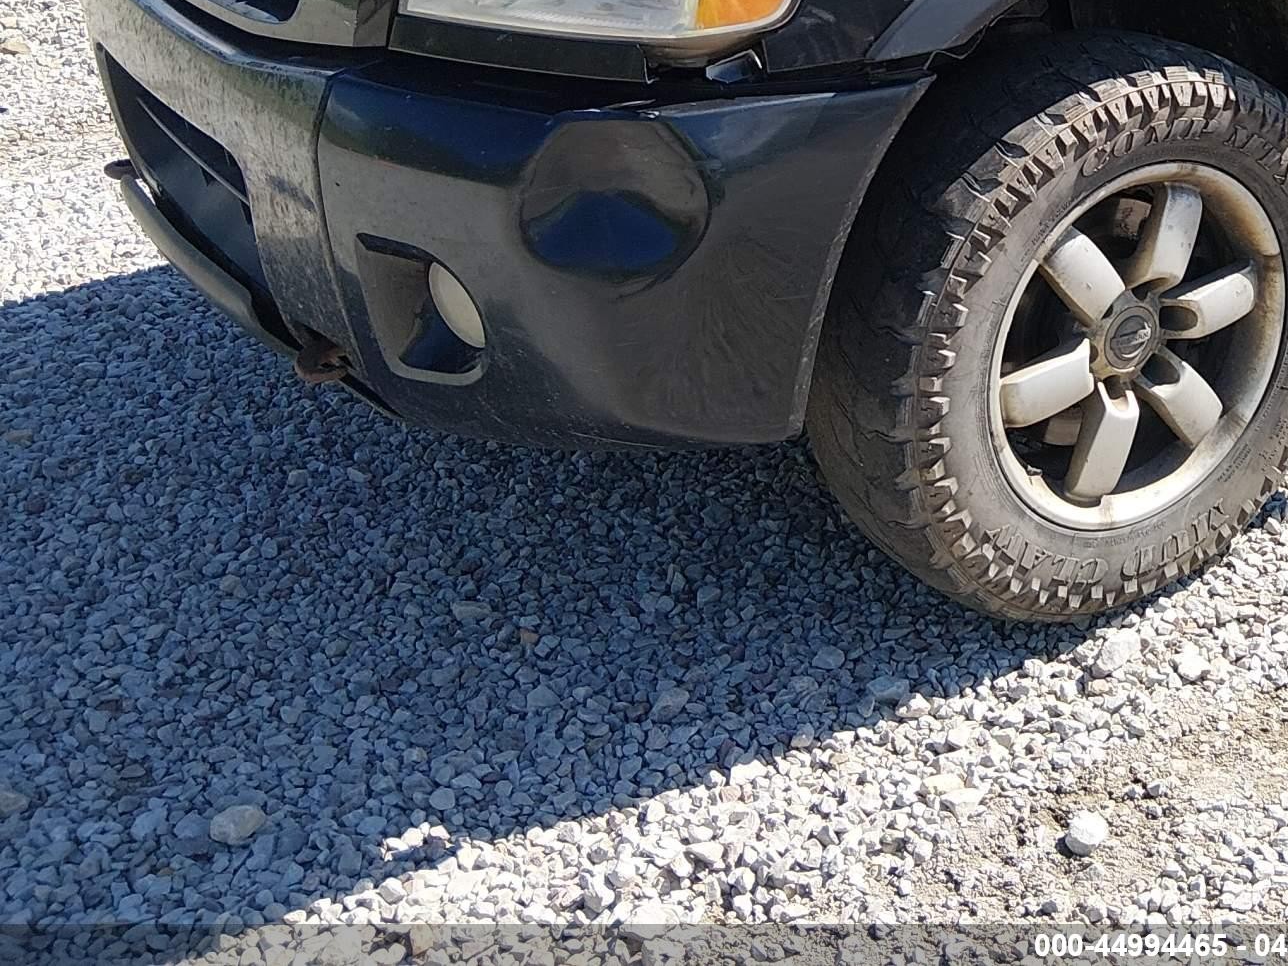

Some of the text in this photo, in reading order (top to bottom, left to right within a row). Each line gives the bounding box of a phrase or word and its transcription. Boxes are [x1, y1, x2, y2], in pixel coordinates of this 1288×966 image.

[1082, 117, 1219, 177] COMP
[984, 524, 1109, 585] CLAW
[1120, 498, 1229, 580] MUD
